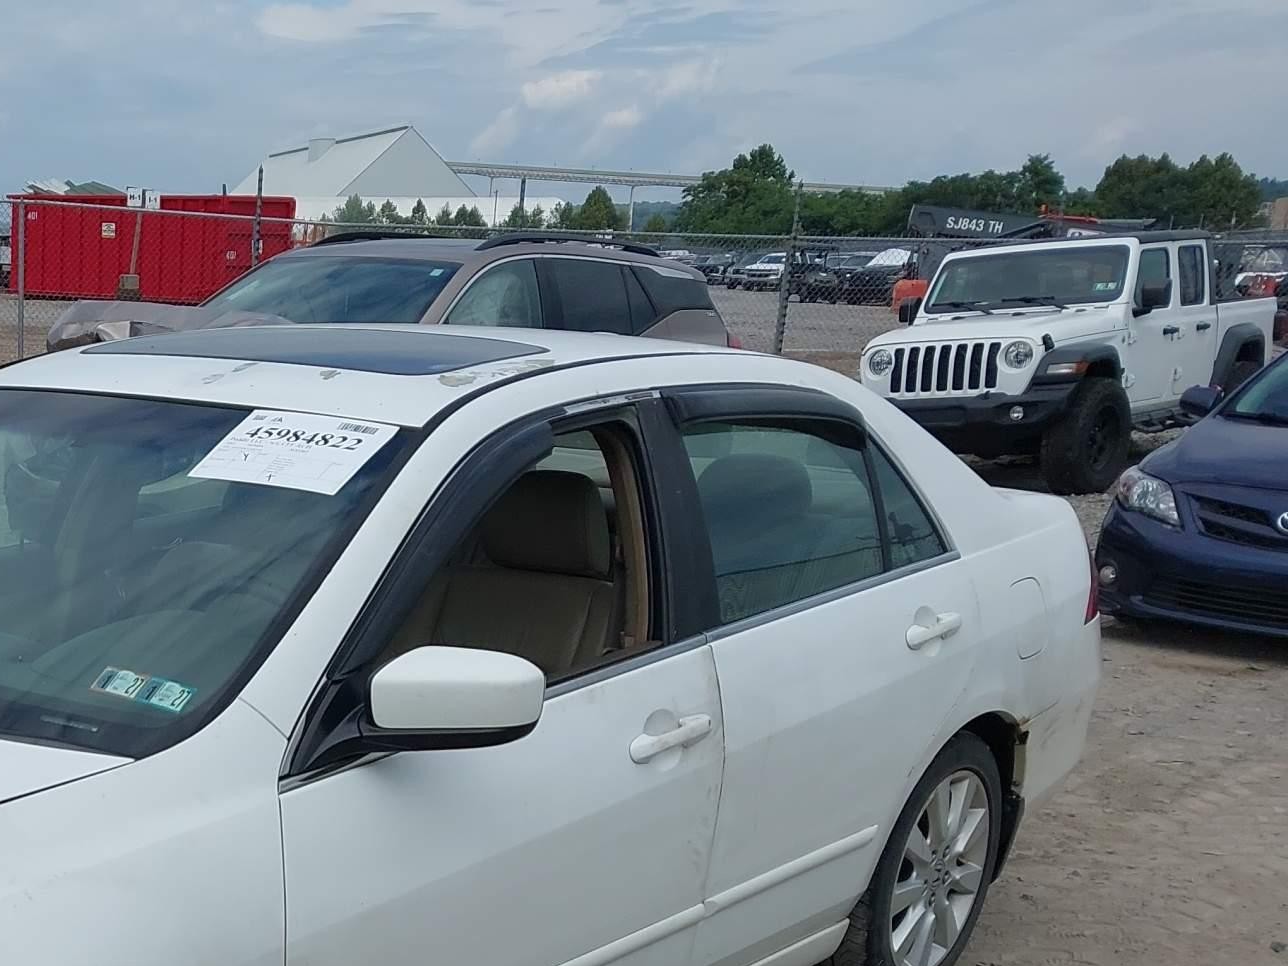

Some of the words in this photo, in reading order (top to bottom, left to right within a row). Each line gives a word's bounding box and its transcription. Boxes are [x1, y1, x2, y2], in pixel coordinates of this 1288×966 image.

[129, 193, 142, 201] H-1
[26, 211, 38, 220] 401
[946, 216, 985, 232] SJ843
[988, 220, 1004, 233] TH
[245, 426, 364, 451] 45984822
